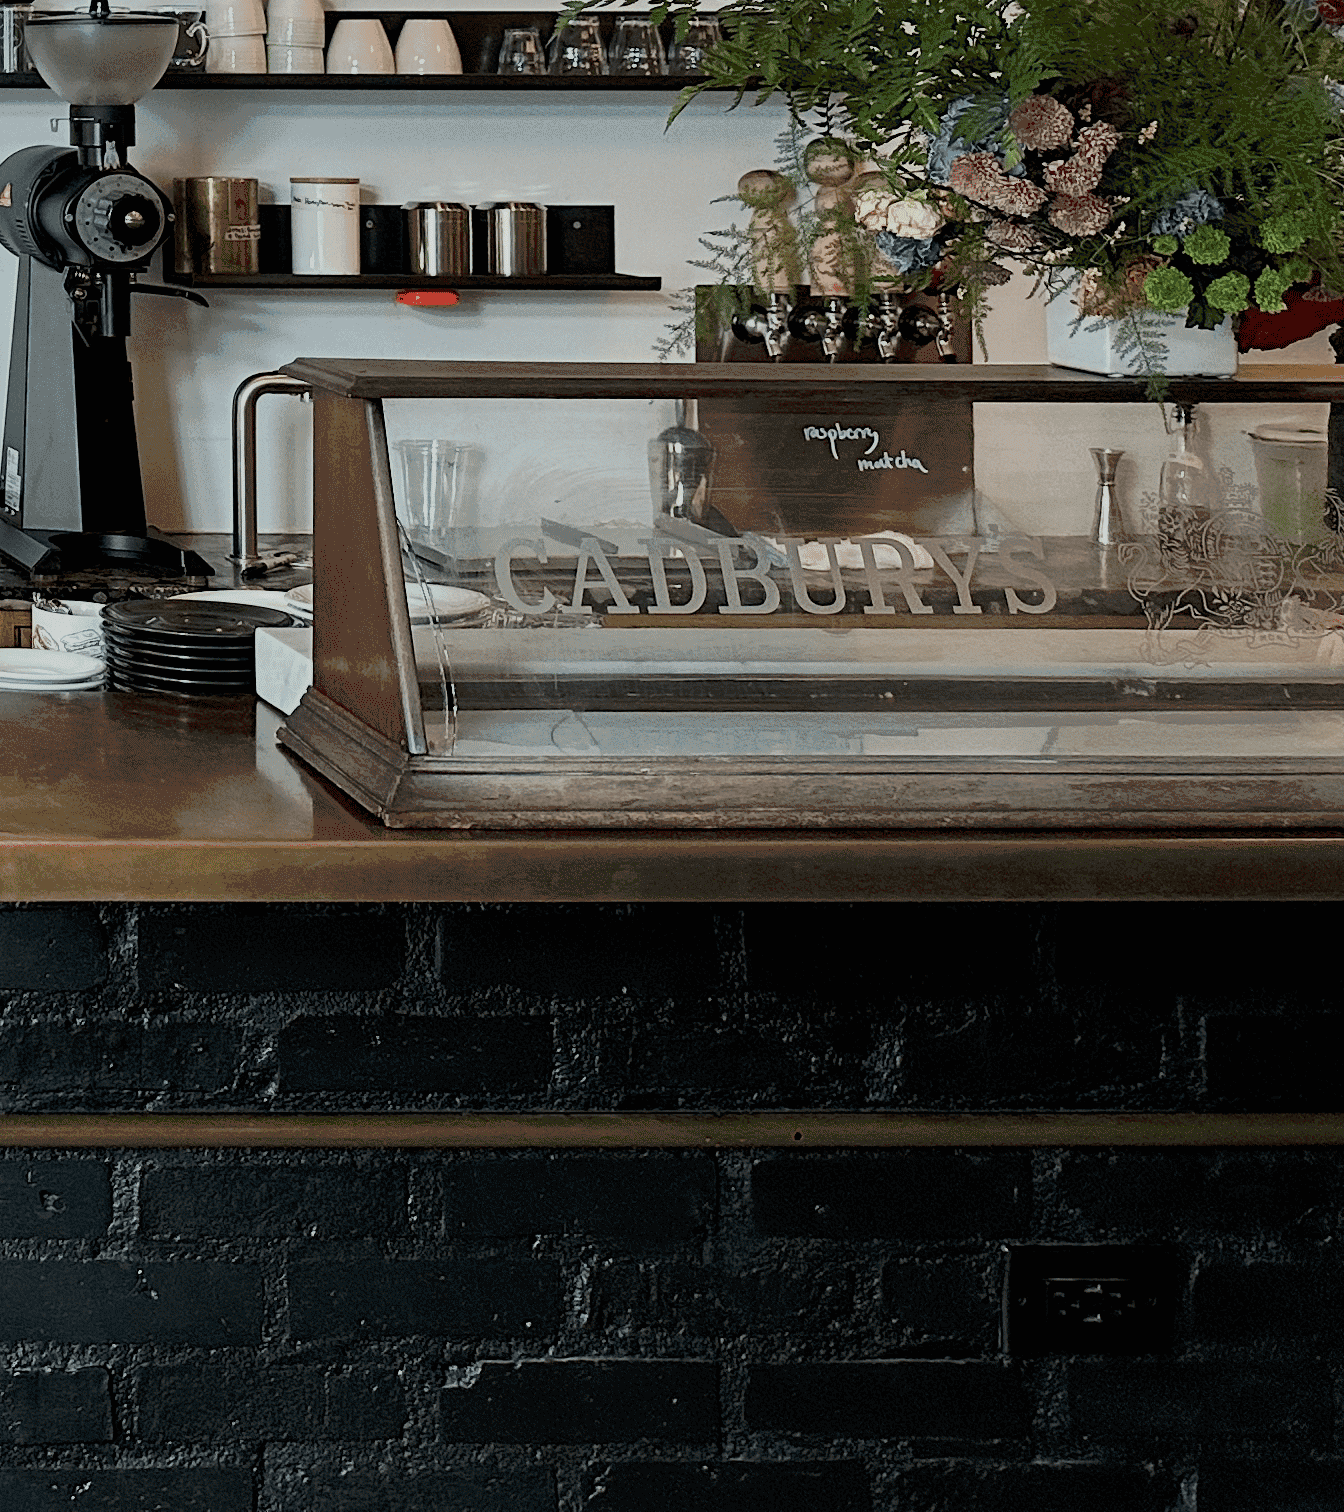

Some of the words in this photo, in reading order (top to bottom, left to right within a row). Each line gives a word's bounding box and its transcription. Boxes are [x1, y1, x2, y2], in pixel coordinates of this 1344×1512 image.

[803, 422, 879, 460] raspberry
[857, 449, 928, 472] matcha
[493, 536, 1057, 616] CADBURYS
